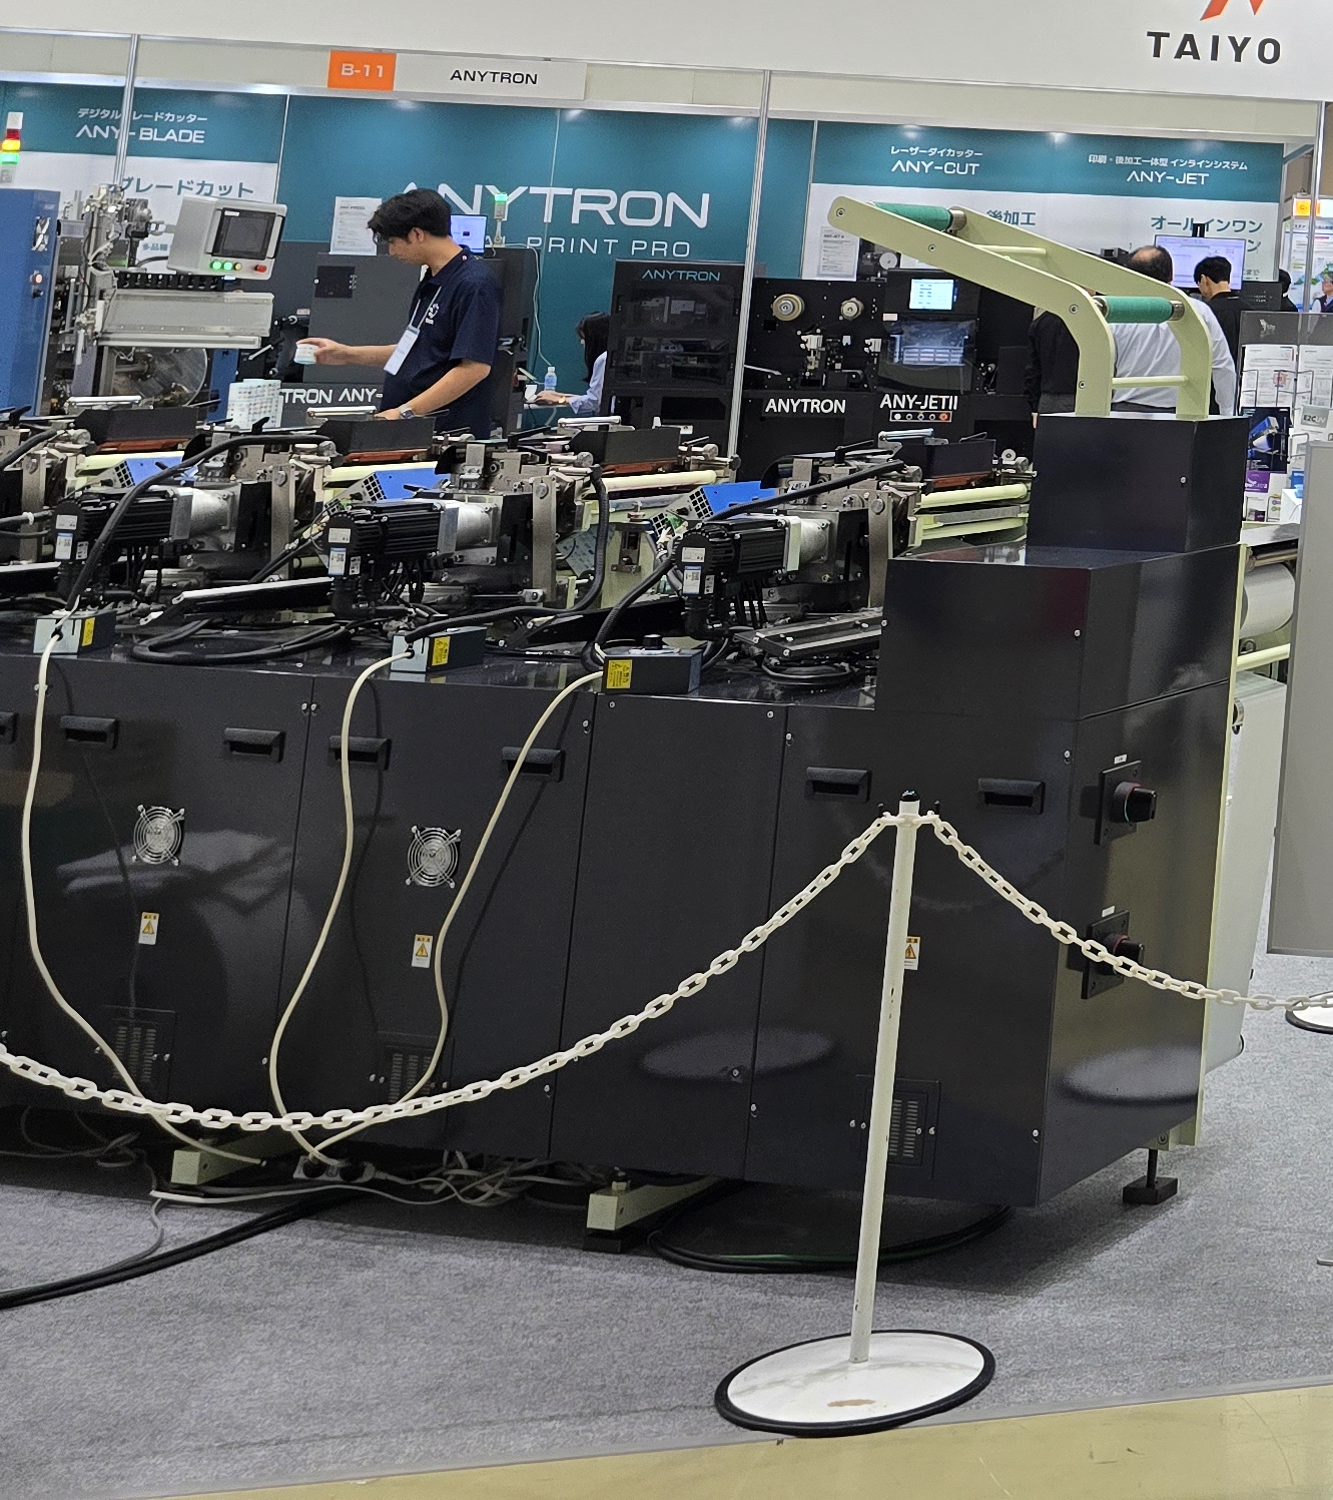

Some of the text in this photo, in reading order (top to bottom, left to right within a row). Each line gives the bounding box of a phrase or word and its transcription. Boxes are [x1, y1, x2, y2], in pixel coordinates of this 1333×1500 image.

[1146, 30, 1282, 65] TAIYO
[341, 63, 538, 85] B-11 ANYTRON
[77, 107, 208, 123] デジタルレードカッター
[75, 123, 206, 144] ANY-BLADE
[890, 145, 984, 158] レーザーダイカッター
[891, 159, 980, 176] ANY-CUT
[1126, 170, 1210, 186] ANY-JET
[403, 181, 711, 229] NYTRON
[526, 236, 619, 255] PRINT
[631, 239, 691, 258] PRO
[641, 269, 721, 282] ANYTRON
[279, 388, 333, 404] TRON
[764, 398, 846, 414] ANYTRON
